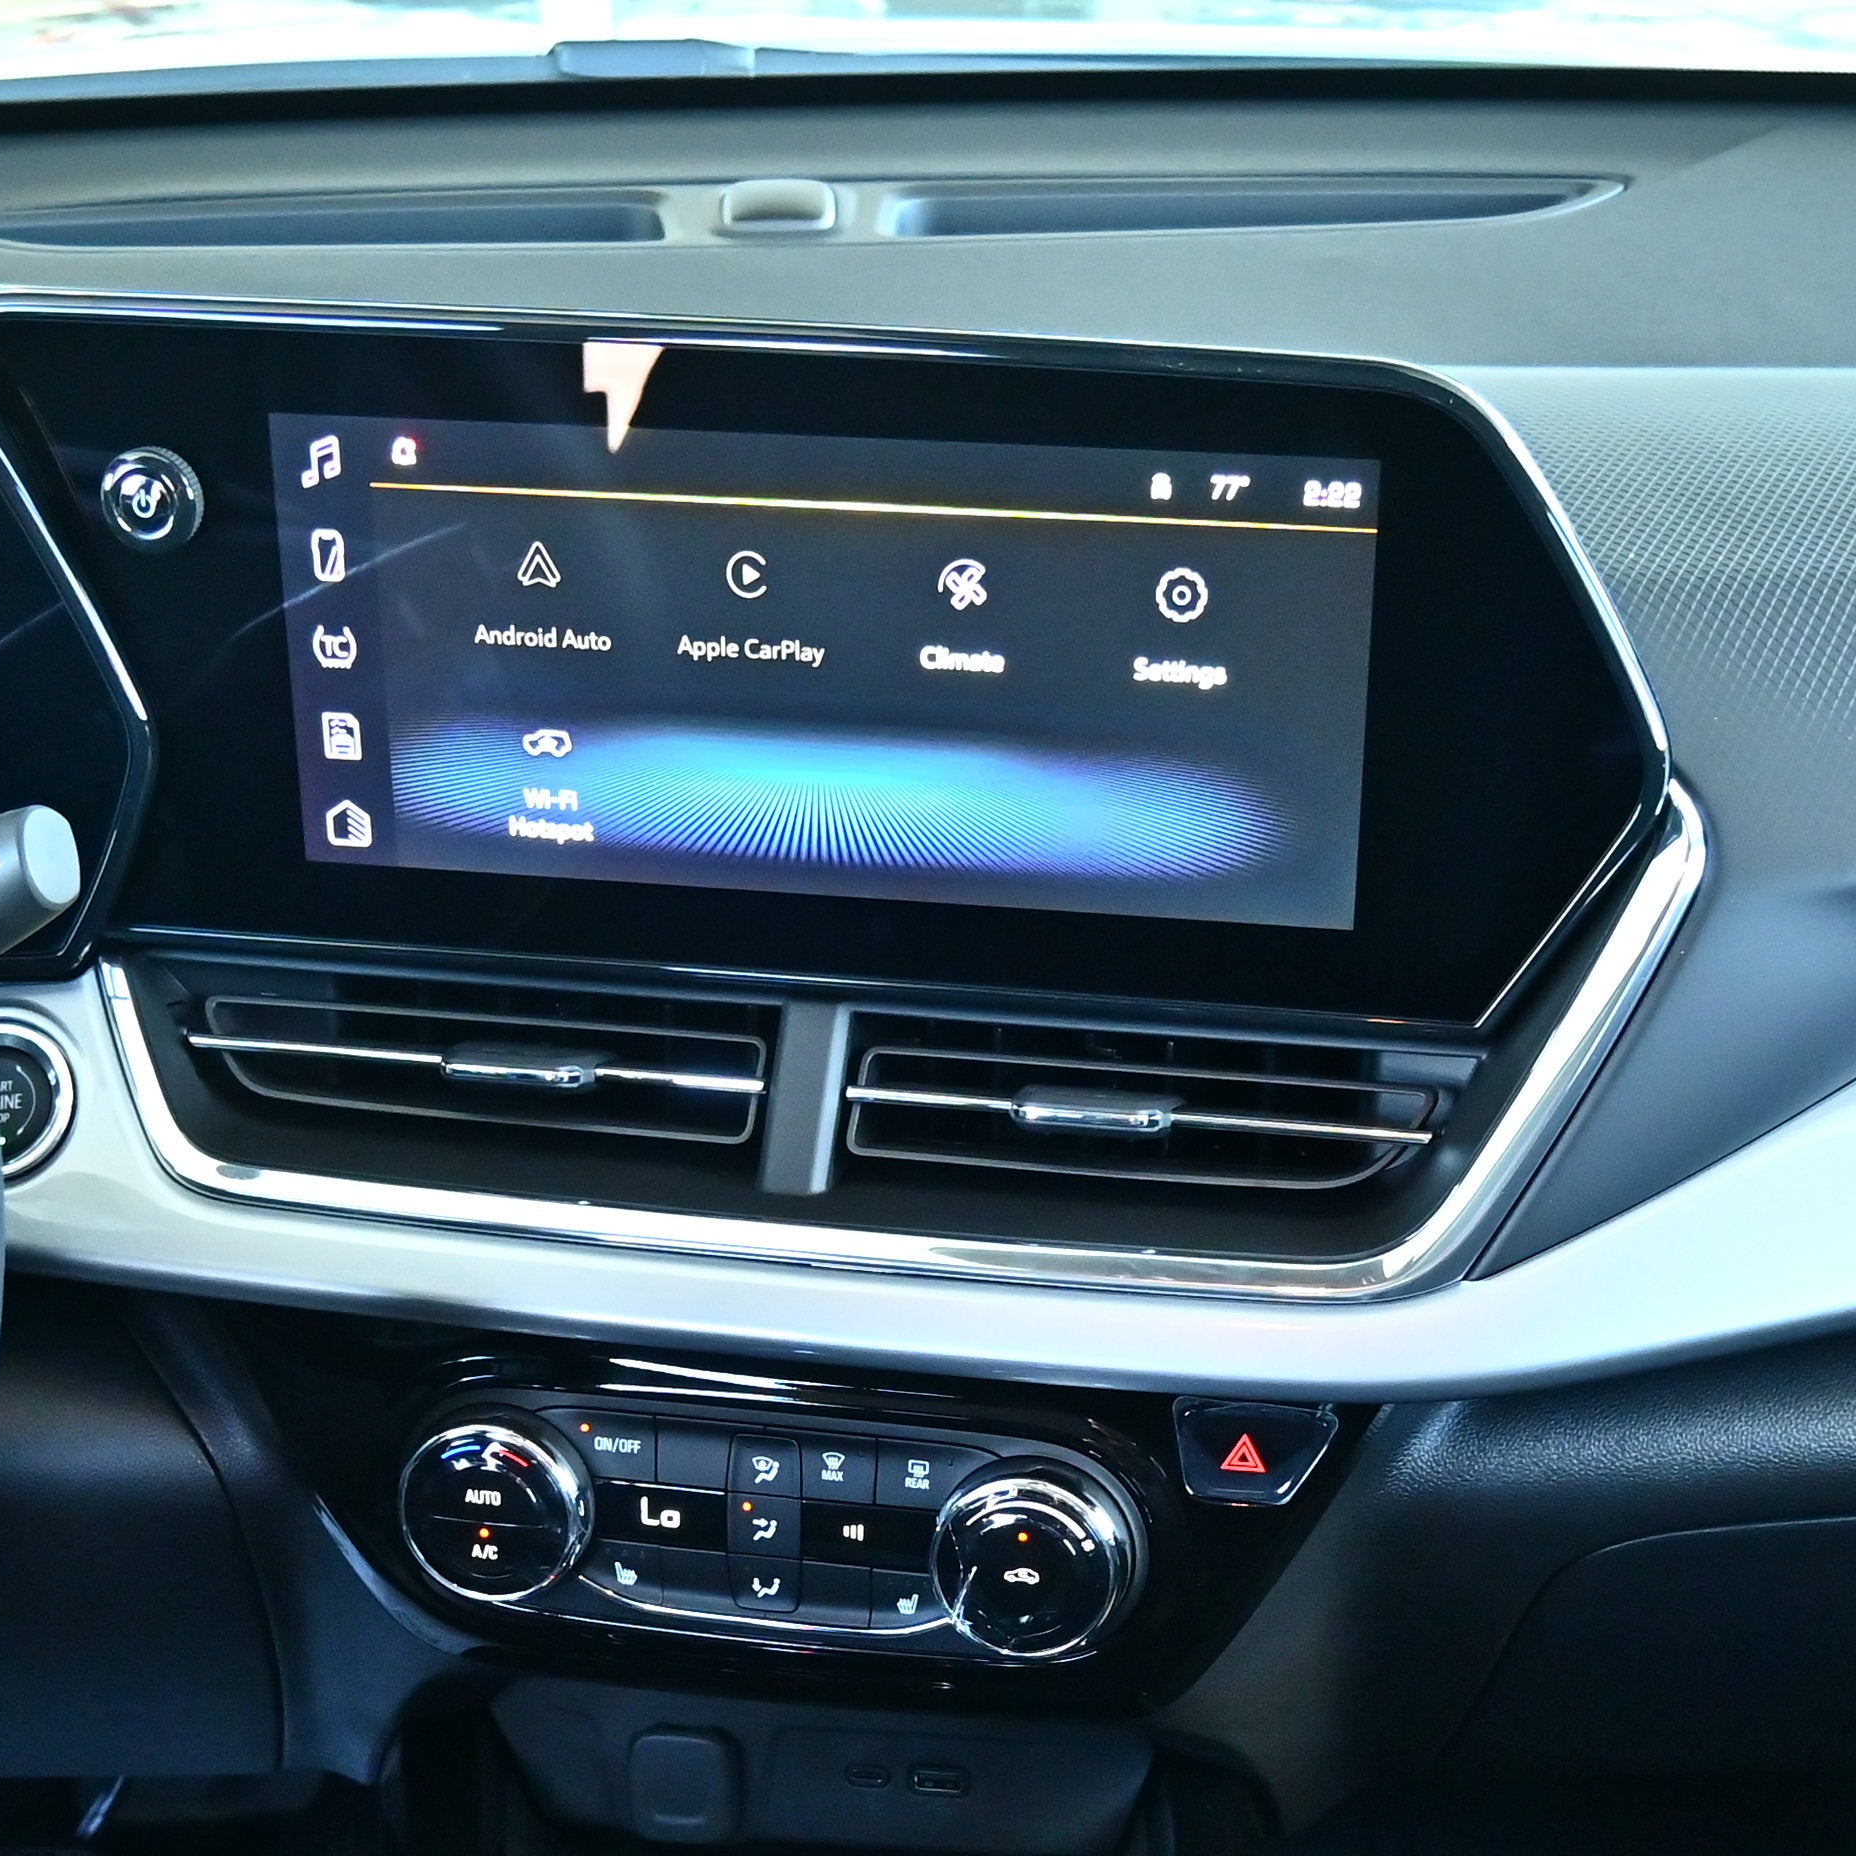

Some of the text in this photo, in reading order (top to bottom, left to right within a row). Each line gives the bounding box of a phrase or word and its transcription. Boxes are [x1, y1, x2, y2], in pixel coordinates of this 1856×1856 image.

[320, 634, 349, 658] TC
[474, 624, 612, 651] Android Auto
[677, 634, 825, 668] Apple CarPlay
[919, 645, 1005, 674] Climate
[1132, 656, 1228, 691] Settings
[522, 787, 578, 811] Wi-Fi
[508, 815, 594, 845] Hotspot
[594, 1436, 642, 1455] ON/OFF
[821, 1470, 844, 1482] MAX
[905, 1477, 930, 1490] REAR
[464, 1488, 501, 1506] AUTO
[640, 1496, 681, 1529] Lo
[471, 1544, 498, 1560] A/C
